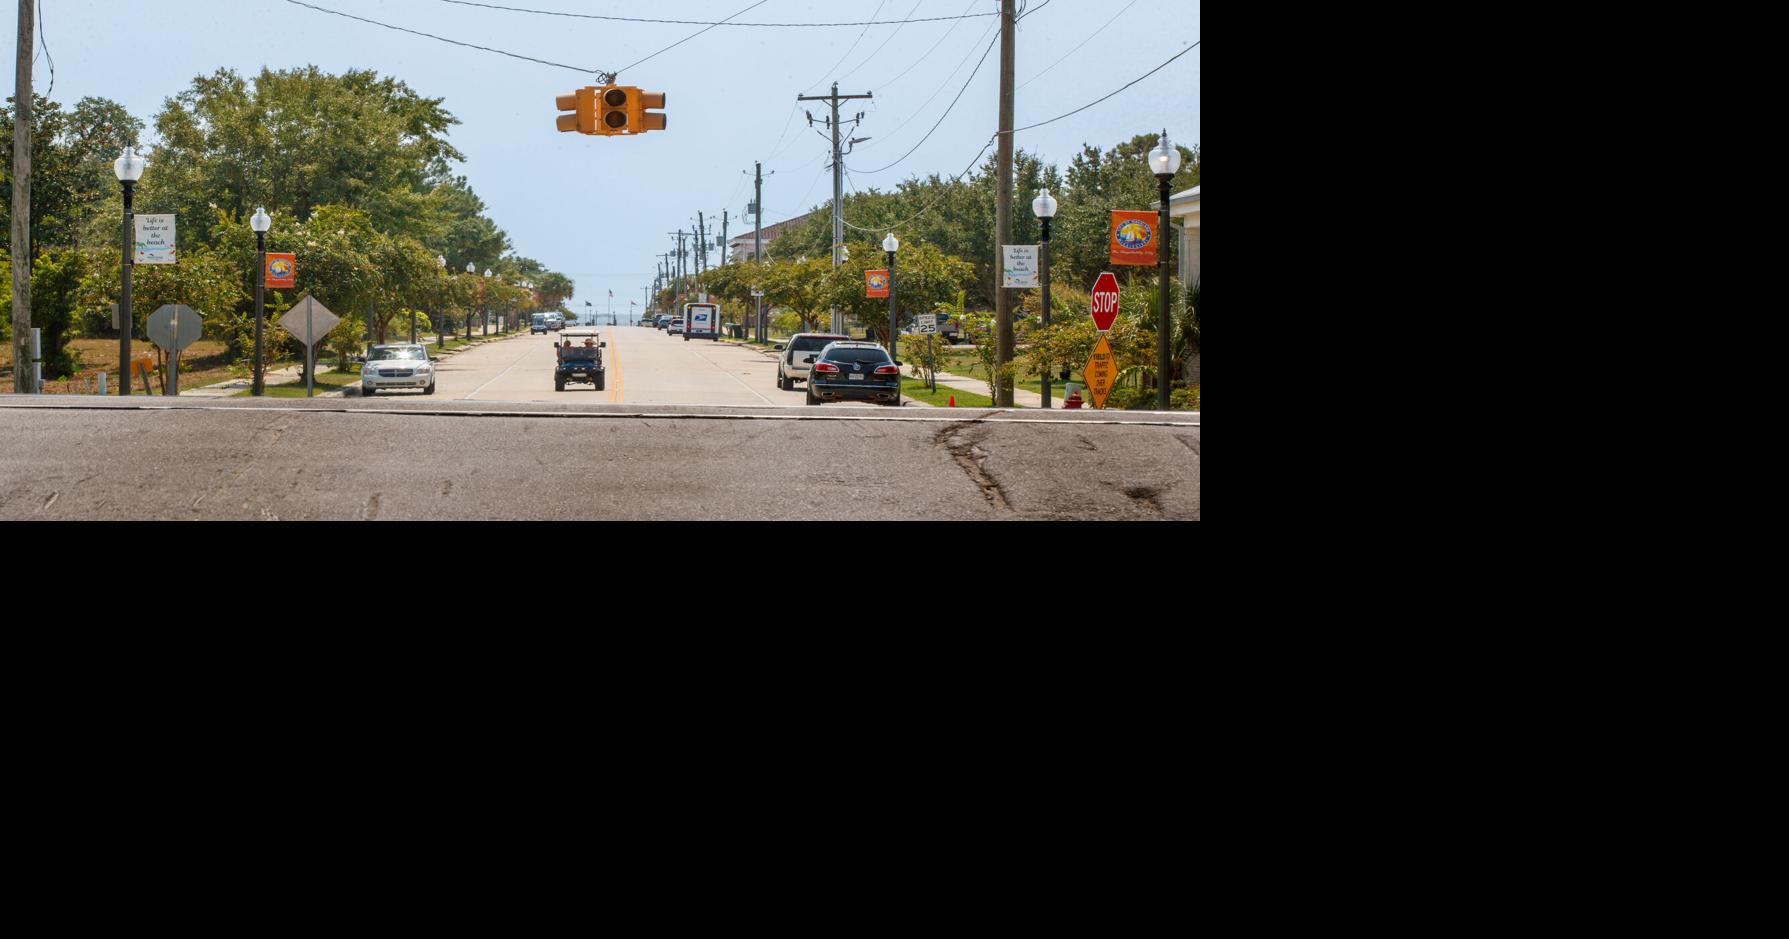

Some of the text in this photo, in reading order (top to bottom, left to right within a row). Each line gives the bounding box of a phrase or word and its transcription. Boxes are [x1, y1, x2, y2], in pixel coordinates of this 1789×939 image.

[146, 217, 158, 225] Life
[1093, 292, 1118, 313] STOP
[920, 324, 936, 333] 25
